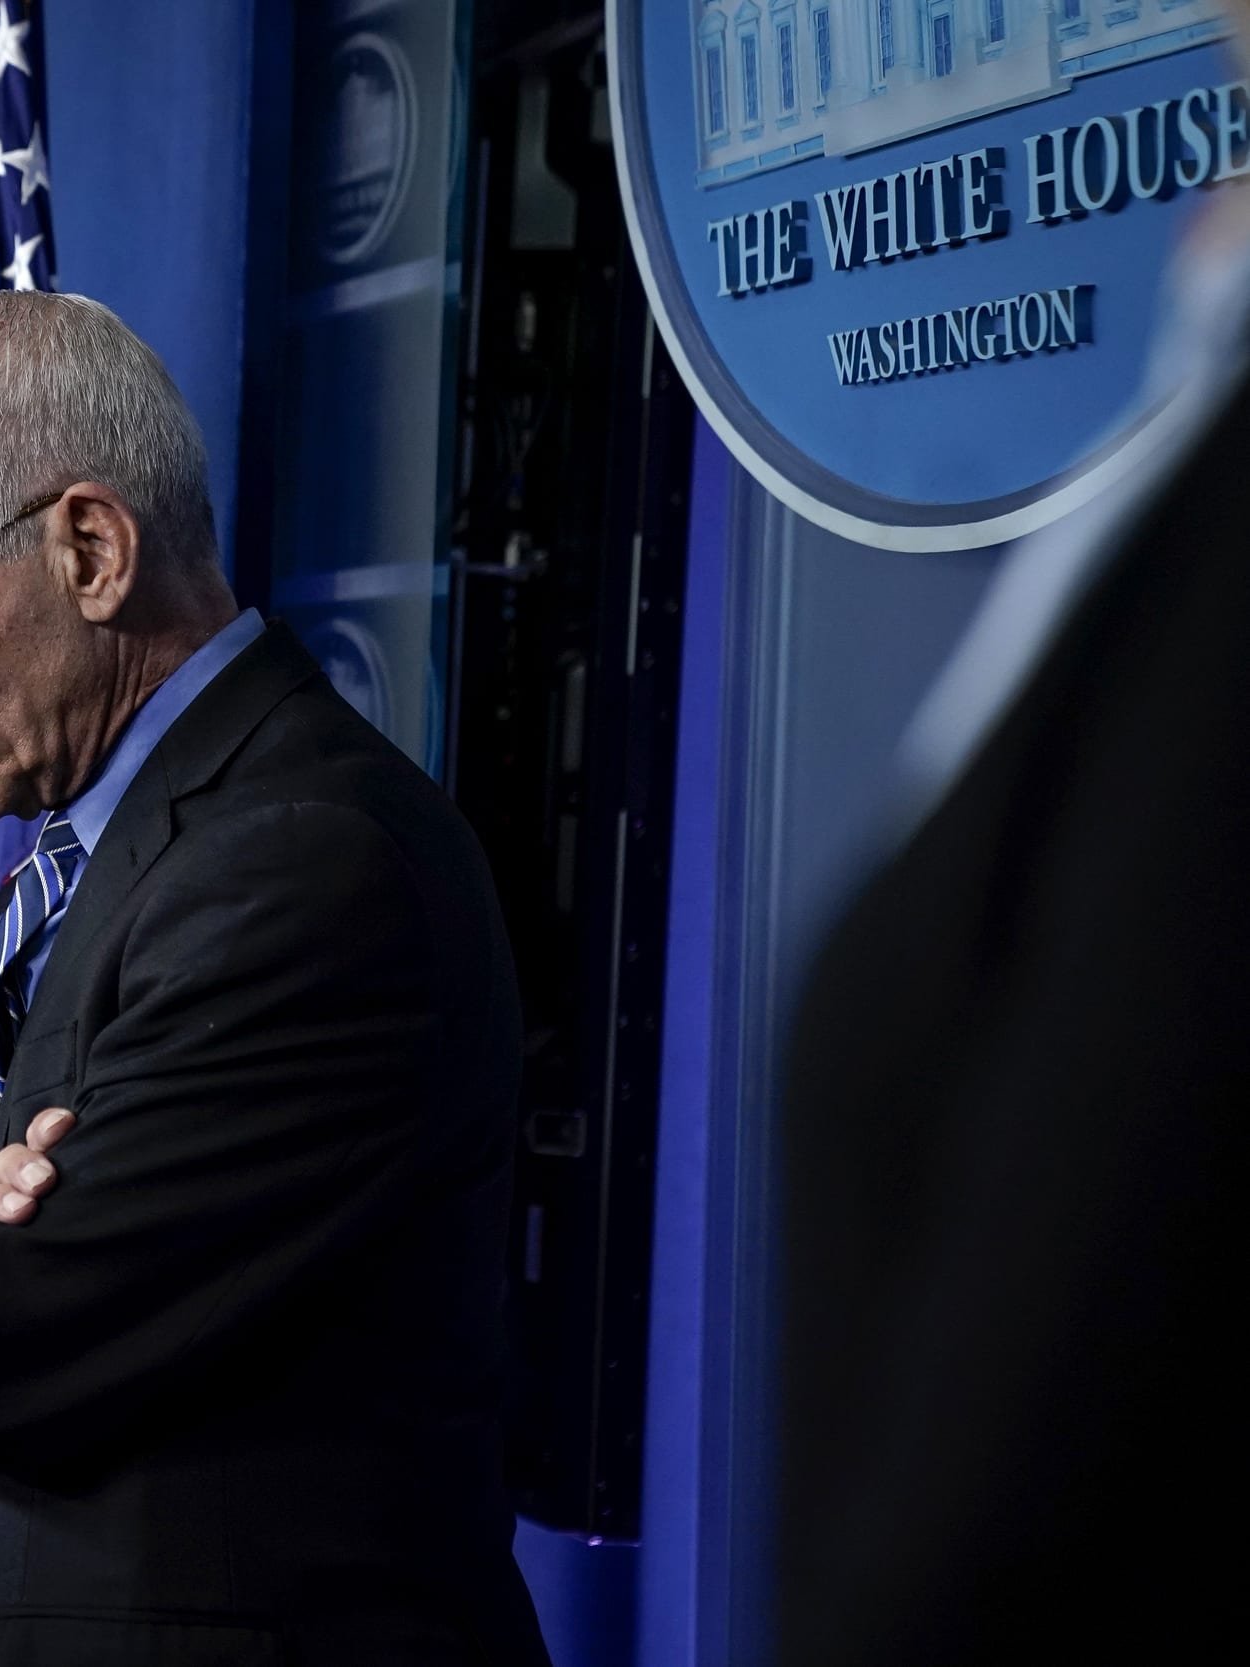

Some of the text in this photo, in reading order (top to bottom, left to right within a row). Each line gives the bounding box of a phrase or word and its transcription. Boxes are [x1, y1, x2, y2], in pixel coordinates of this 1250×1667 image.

[707, 81, 1250, 297] THE WHITE HOUSE
[827, 286, 1080, 385] WASHINGTON
